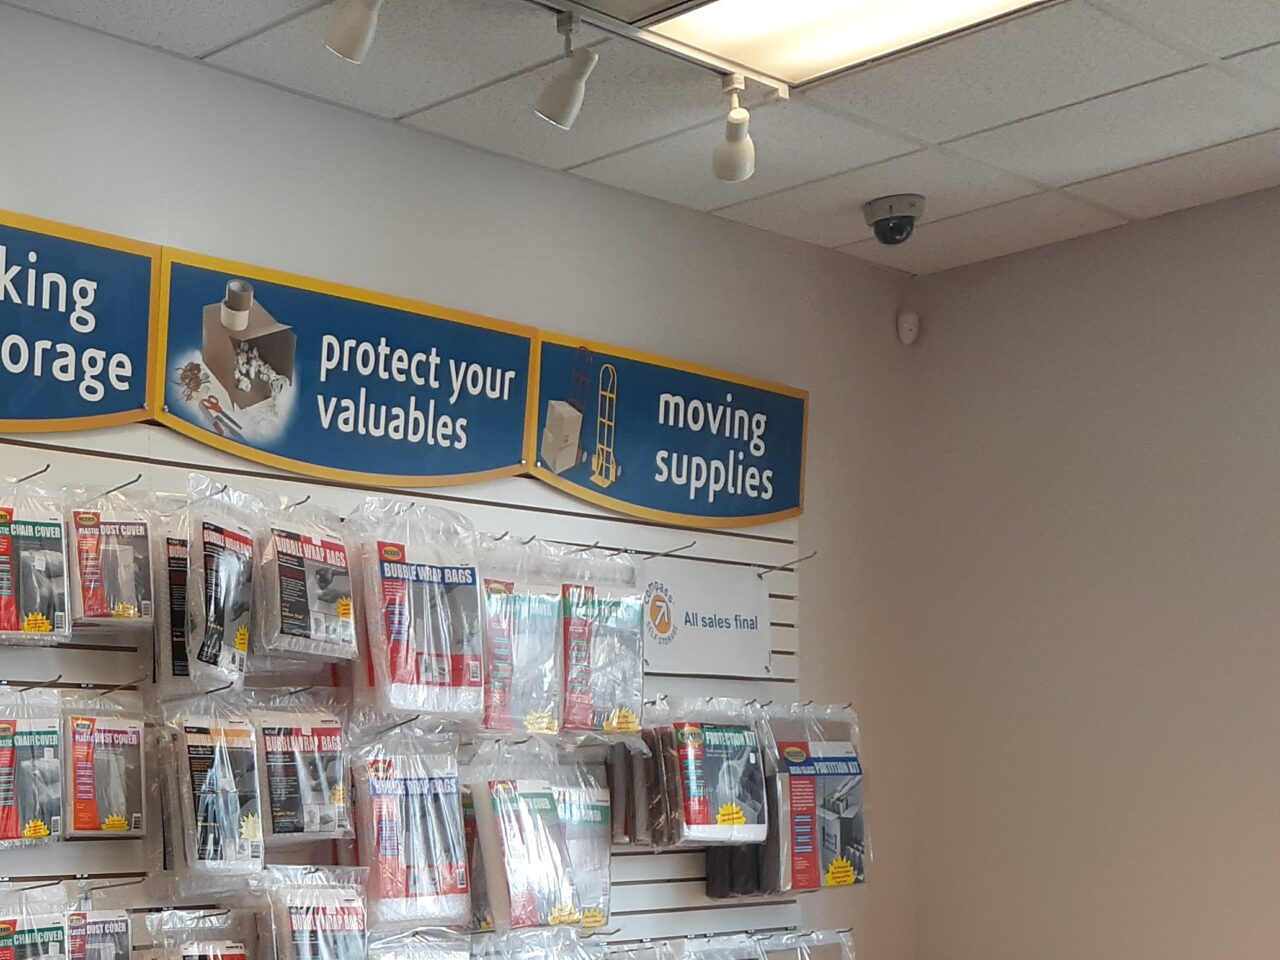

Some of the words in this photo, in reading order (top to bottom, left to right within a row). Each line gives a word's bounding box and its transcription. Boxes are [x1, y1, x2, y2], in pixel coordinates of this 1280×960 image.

[320, 334, 441, 389] protect
[449, 359, 516, 405] your
[317, 387, 468, 449] valuables
[658, 393, 767, 457] moving
[654, 450, 773, 503] supplies
[10, 524, 34, 536] CHAIR
[34, 525, 61, 538] COVER
[79, 527, 99, 535] PLASTIC
[100, 525, 120, 536] DUST
[121, 525, 145, 535] COVER
[275, 536, 304, 556] BUBBLE
[303, 542, 325, 561] WRAP
[326, 548, 346, 567] BAGS
[384, 562, 417, 580] BUBBLE
[417, 565, 442, 582] WRAP
[444, 568, 472, 584] BAGS
[684, 611, 698, 627] All
[701, 614, 731, 629] sales
[734, 614, 759, 631] final
[14, 735, 36, 746] CHAIR
[35, 735, 59, 746] COVER
[114, 733, 137, 744] COVER
[321, 736, 342, 751] BAGS
[744, 731, 758, 746] KIT
[847, 761, 861, 774] KIT
[430, 778, 456, 793] BAGS
[86, 924, 104, 934] DUST
[345, 914, 364, 930] BAGS
[38, 930, 64, 943] COVER
